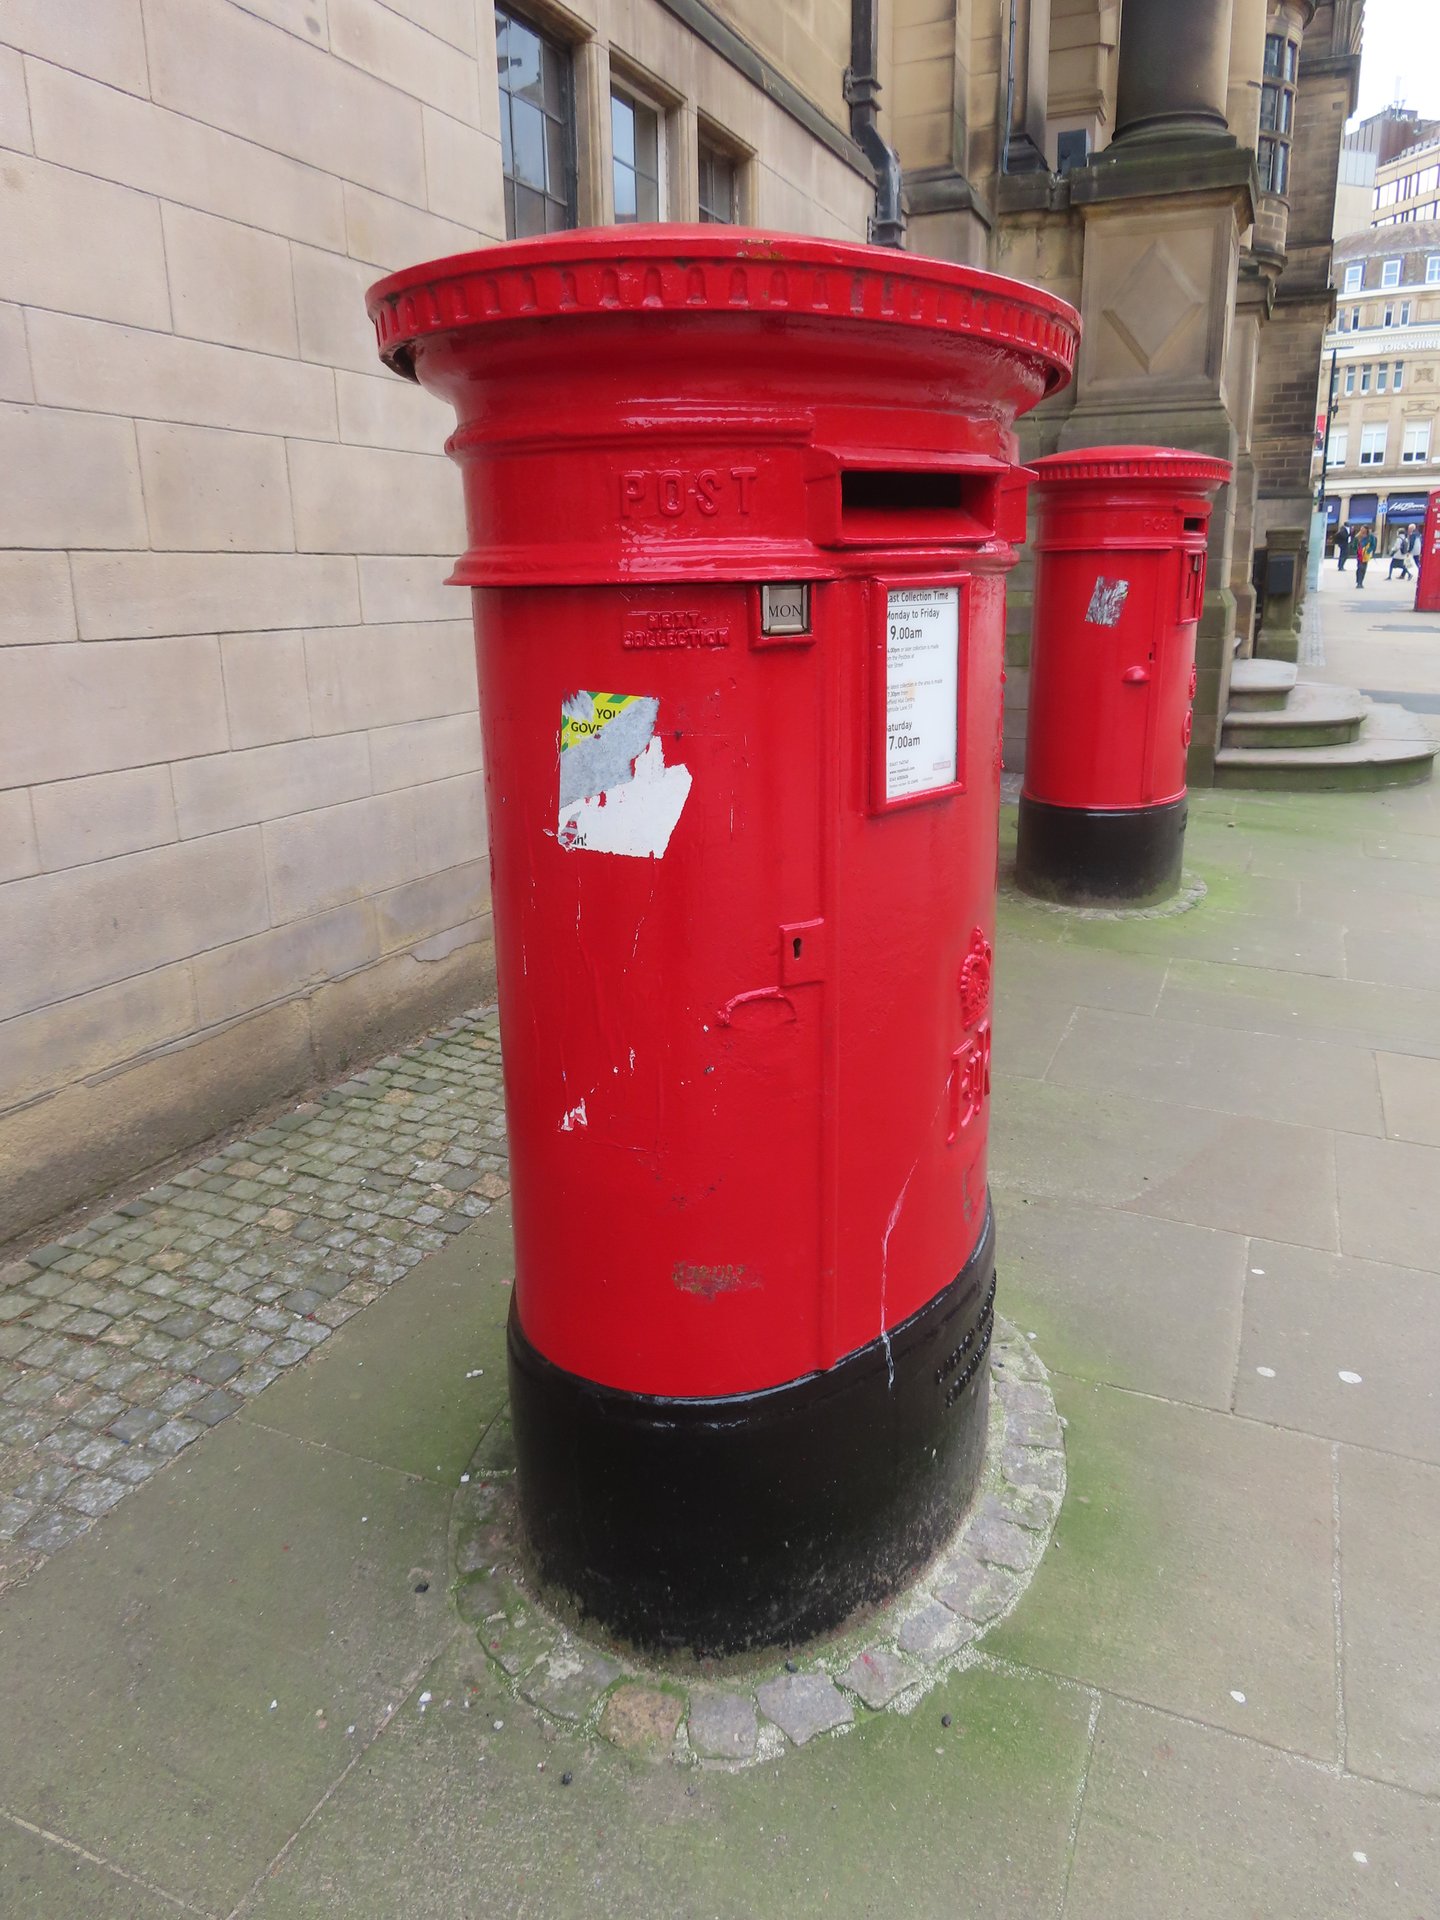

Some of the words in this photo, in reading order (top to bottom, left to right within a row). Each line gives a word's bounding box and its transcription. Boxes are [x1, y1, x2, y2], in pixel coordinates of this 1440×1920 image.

[619, 466, 757, 518] POST
[1143, 516, 1177, 530] POST
[888, 593, 899, 603] ast
[901, 592, 932, 602] Collection
[933, 591, 949, 601] Time
[769, 605, 801, 618] MON
[912, 611, 918, 619] to
[920, 608, 940, 619] Friday
[647, 611, 700, 630] NEXT
[623, 628, 730, 649] COLLECTION
[890, 625, 923, 640] 9.00am
[887, 720, 913, 732] aturday
[889, 735, 921, 751] 7.00am
